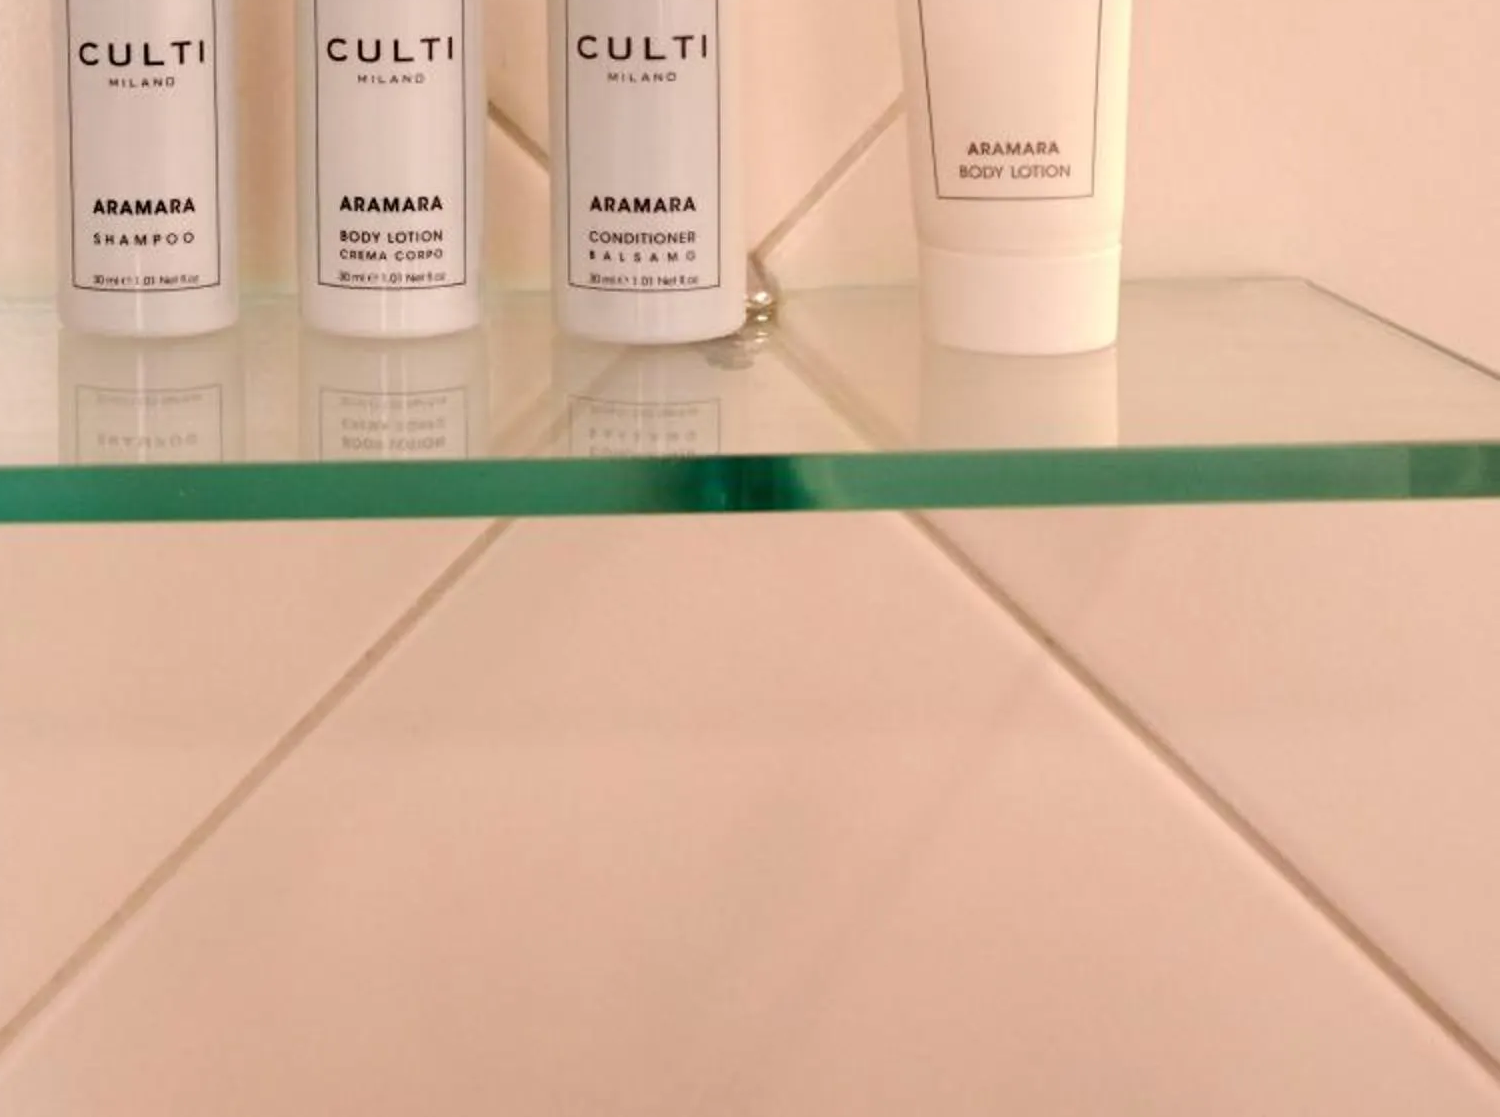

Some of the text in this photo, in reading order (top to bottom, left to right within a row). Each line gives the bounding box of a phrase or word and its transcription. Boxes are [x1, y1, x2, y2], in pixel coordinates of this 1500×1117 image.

[78, 39, 205, 68] CULTI
[326, 36, 453, 64] CULTI
[576, 34, 707, 62] CULTI
[108, 76, 176, 89] MILANO
[356, 72, 426, 85] MILANO
[606, 70, 677, 84] MILANO
[967, 140, 1060, 156] ARAMARA
[958, 163, 1071, 180] BODY LOTION
[92, 196, 196, 216] ARAMARA
[339, 195, 444, 213] ARAMARA
[589, 195, 697, 214] ARAMARA
[92, 231, 195, 247] SHAMPOO
[339, 229, 444, 245] BODY LOTION
[588, 230, 697, 246] CONDITIONER
[339, 247, 444, 261] CREMA CORPO
[588, 249, 696, 263] BALSAMO
